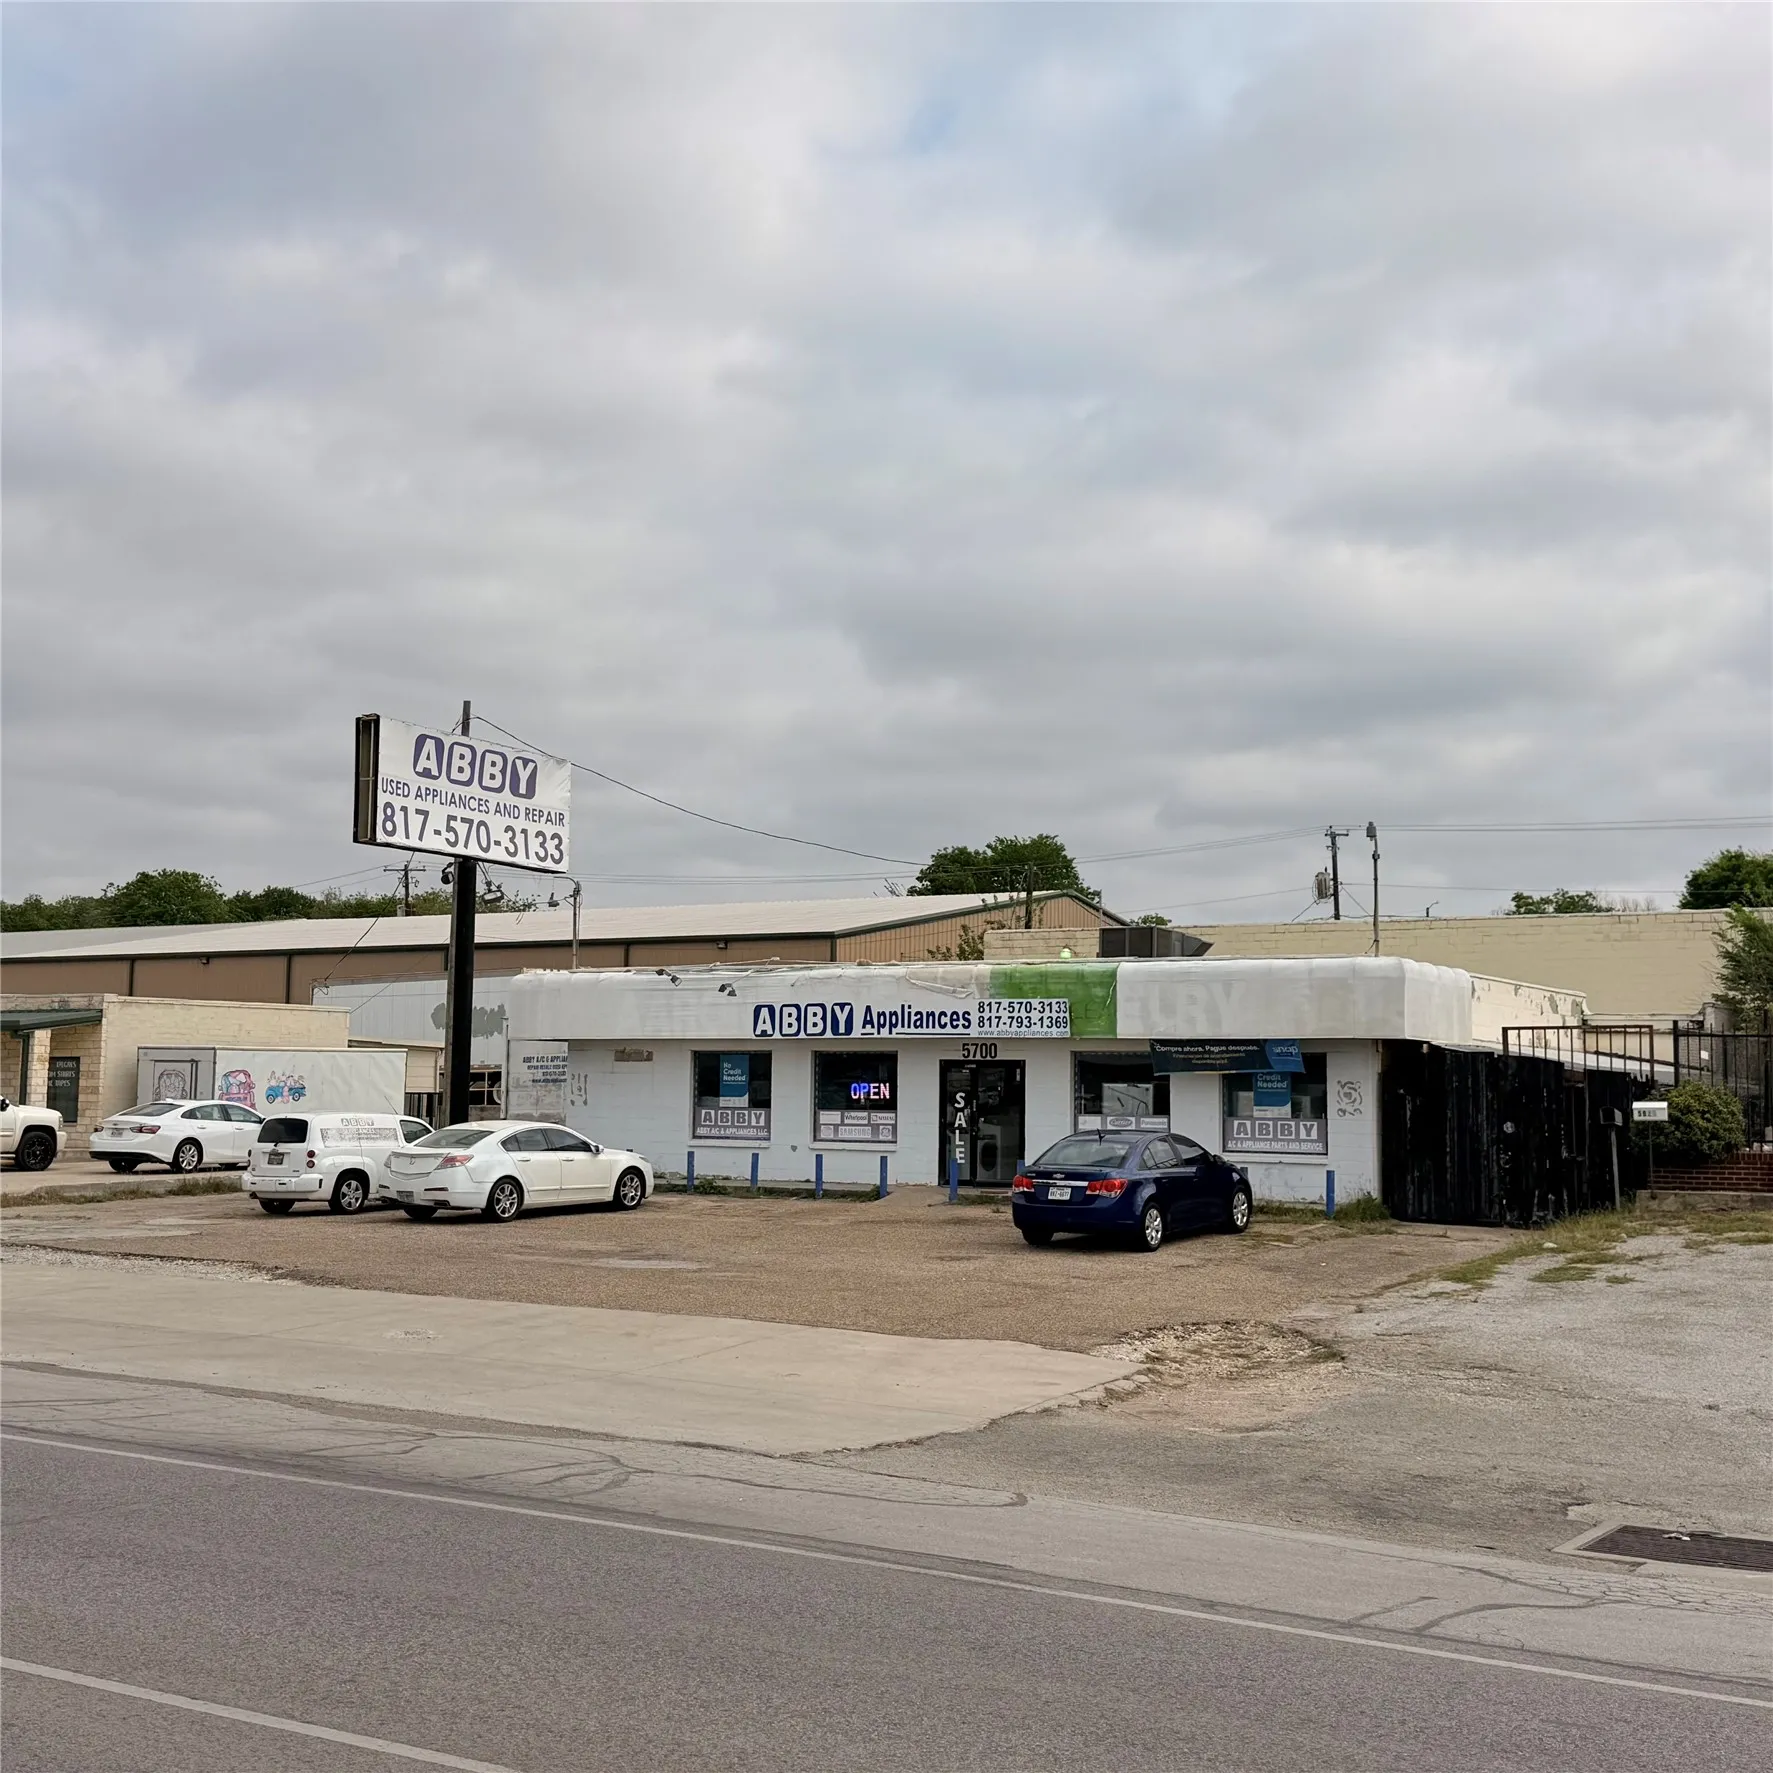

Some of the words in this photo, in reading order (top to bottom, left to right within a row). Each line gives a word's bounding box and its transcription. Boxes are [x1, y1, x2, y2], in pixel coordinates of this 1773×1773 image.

[413, 734, 538, 799] ABBY
[381, 777, 410, 798] USED
[414, 785, 490, 814] APPLIANCES
[494, 802, 521, 819] AND
[524, 807, 565, 827] REPAIR
[381, 801, 564, 865] 817-570-3133
[977, 1001, 1068, 1014] 817-570-3133
[753, 1002, 854, 1037] ABBY
[861, 1004, 972, 1035] Appliances
[977, 1015, 1068, 1029] 817-793-1369
[977, 1029, 1069, 1037] www.abbyappliances.com
[961, 1043, 998, 1059] 5700
[850, 1083, 890, 1100] OPEN
[341, 1118, 374, 1126] ABBY
[701, 1109, 765, 1126] ABBY
[725, 1128, 757, 1136] APPLIANCES
[839, 1128, 871, 1137] SAMSUNG
[954, 1092, 967, 1164] SALE
[1234, 1120, 1317, 1139] ABBY
[1242, 1140, 1271, 1149] APPLIANCE
[1271, 1141, 1288, 1149] PARTS
[1300, 1142, 1323, 1151] SERVICE
